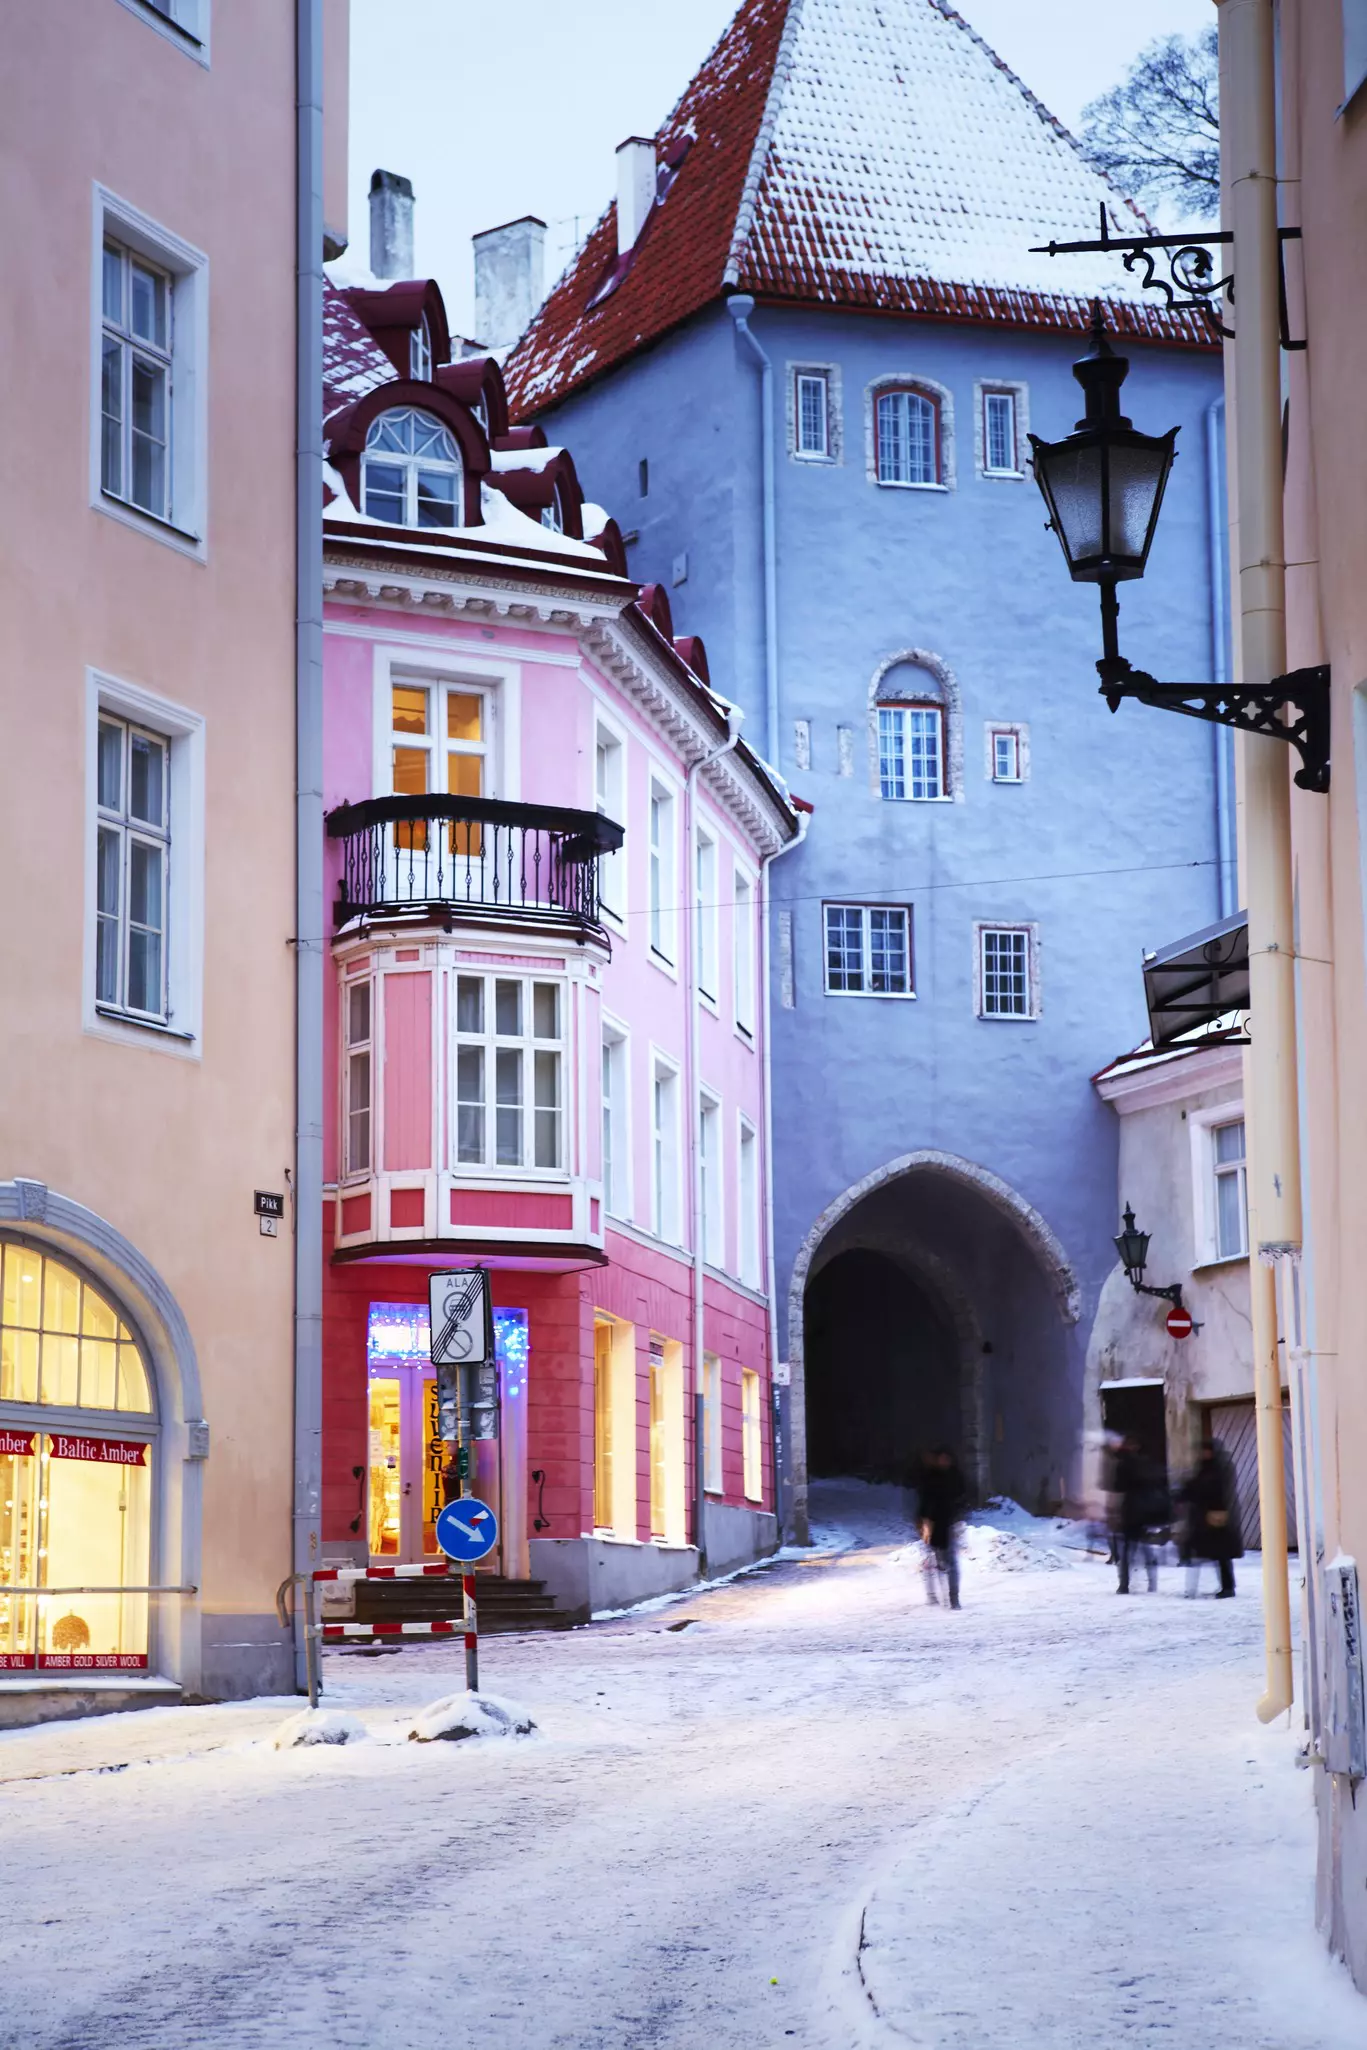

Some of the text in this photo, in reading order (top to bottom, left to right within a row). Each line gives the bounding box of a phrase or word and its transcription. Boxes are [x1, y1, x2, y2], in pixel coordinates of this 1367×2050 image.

[261, 1196, 278, 1210] Pikk
[266, 1219, 273, 1233] 2
[446, 1277, 469, 1288] ALA
[57, 1437, 140, 1464] Baltic Amber
[44, 1656, 140, 1667] AMBER GOLD SILVER WOOL
